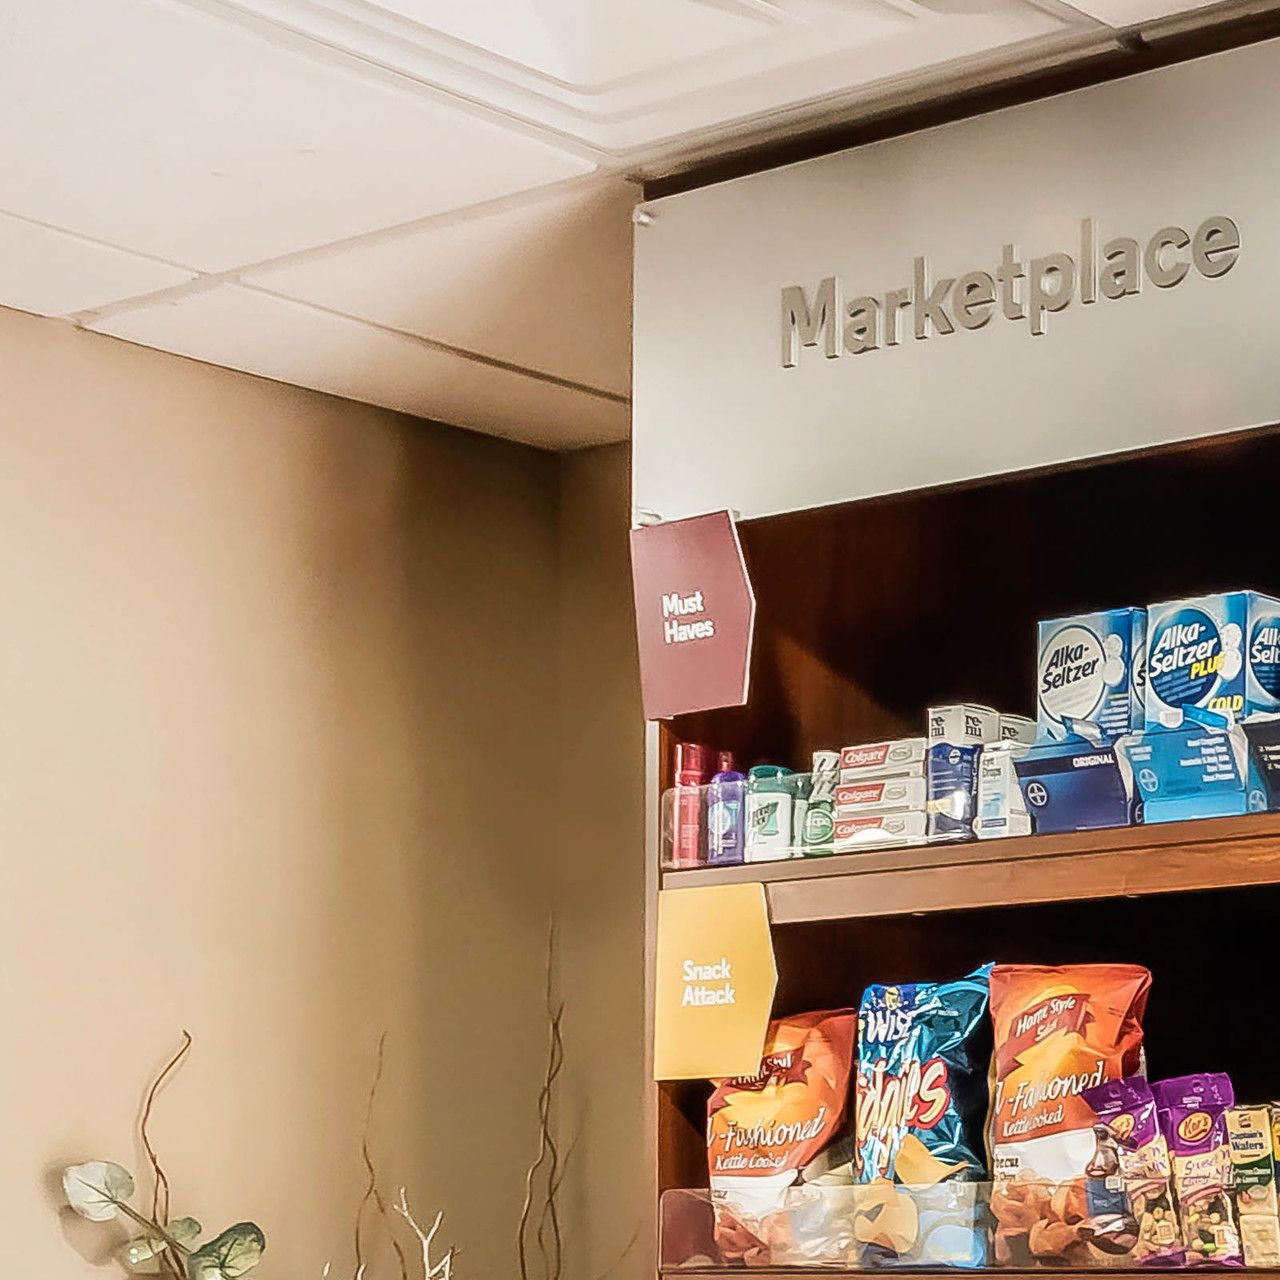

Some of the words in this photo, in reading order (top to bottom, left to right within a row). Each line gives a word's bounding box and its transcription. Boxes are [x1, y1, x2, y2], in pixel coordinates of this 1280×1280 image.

[779, 213, 1242, 368] Marketplace
[662, 590, 704, 618] Must
[663, 618, 715, 644] Haves
[1154, 623, 1206, 650] Alka-
[1046, 643, 1090, 672] Alka-
[1149, 637, 1217, 678] Seltzer
[1190, 653, 1226, 680] PLUS
[1041, 657, 1099, 695] Seltzer
[1208, 695, 1244, 711] COLD
[964, 726, 982, 738] nu
[844, 750, 886, 764] Colgate
[1073, 753, 1114, 768] ORIGINAL
[838, 789, 880, 802] Colgate
[682, 958, 732, 981] Snack
[681, 984, 735, 1007] Attack
[1015, 1008, 1049, 1037] Home
[1050, 996, 1076, 1014] Style
[1232, 1141, 1264, 1151] Wafers
